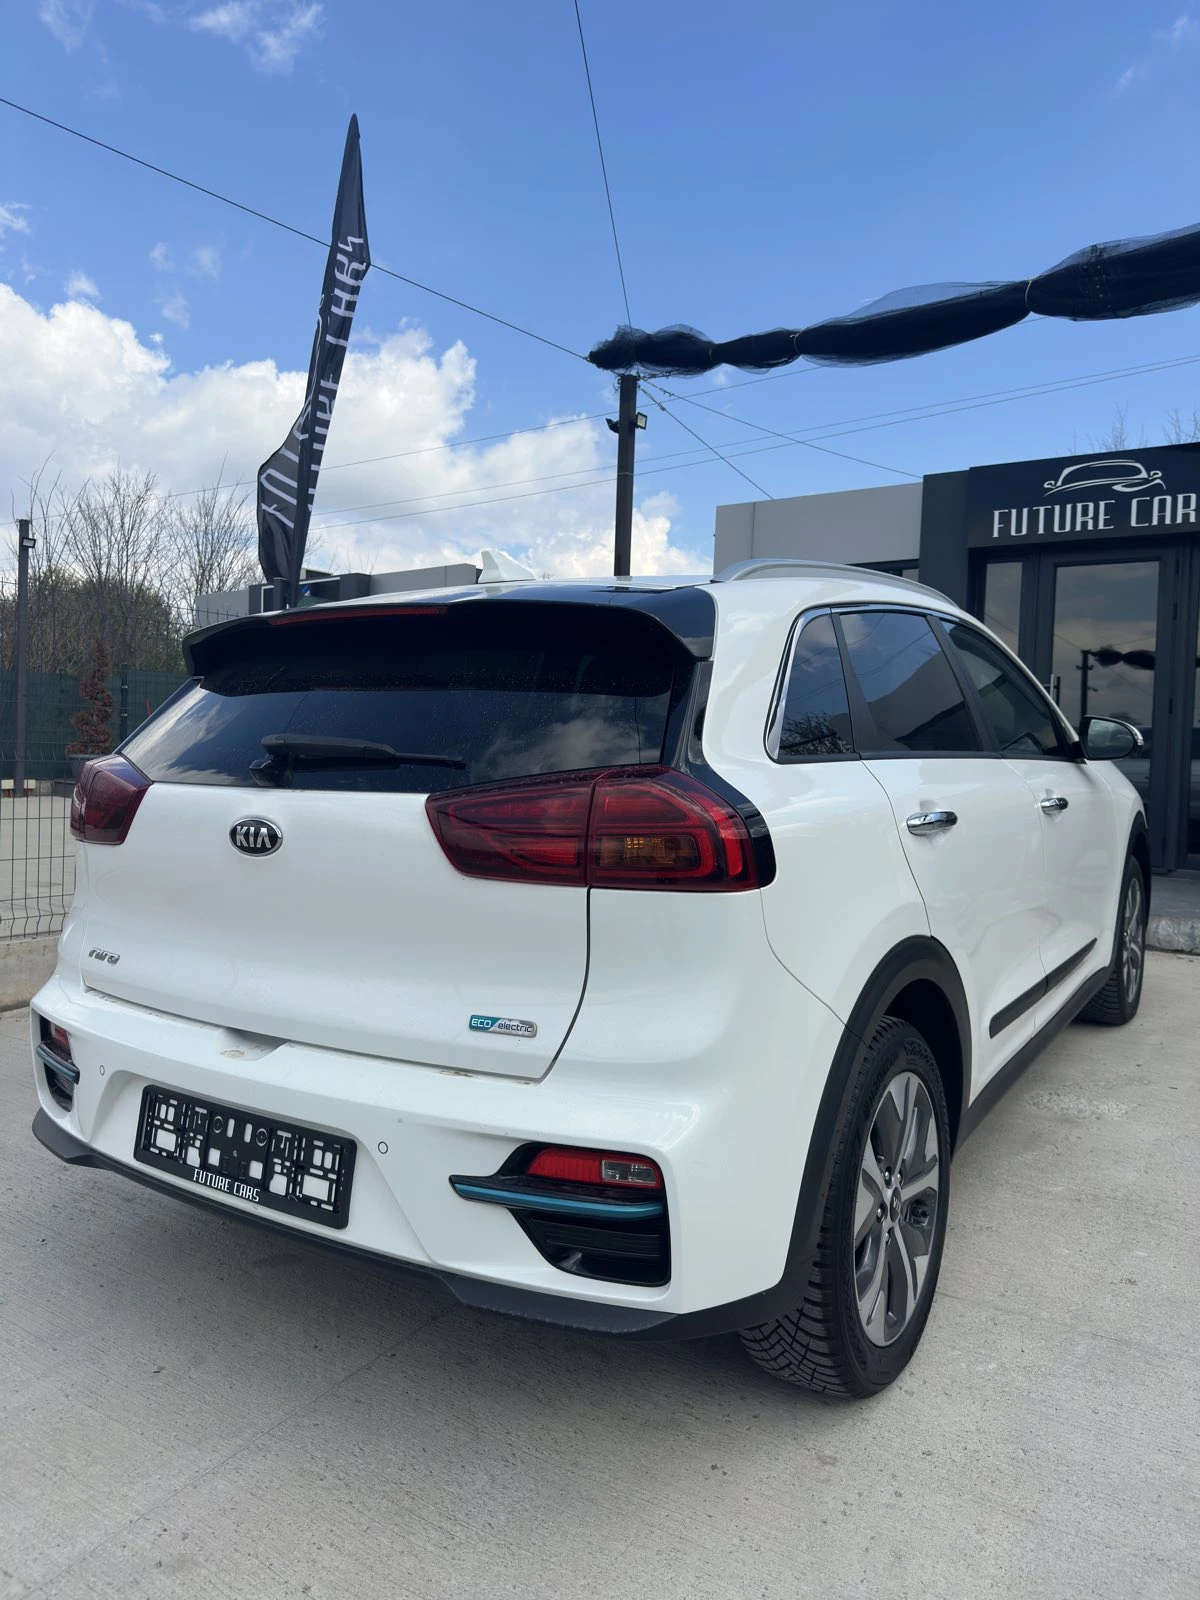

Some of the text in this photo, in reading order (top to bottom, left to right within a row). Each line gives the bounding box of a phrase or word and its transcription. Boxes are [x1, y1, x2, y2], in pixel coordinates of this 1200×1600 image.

[992, 493, 1196, 538] FUTURE CAR
[236, 825, 272, 849] KIA
[471, 1018, 533, 1033] ECO electric
[193, 1168, 260, 1202] FUTURE CARS
